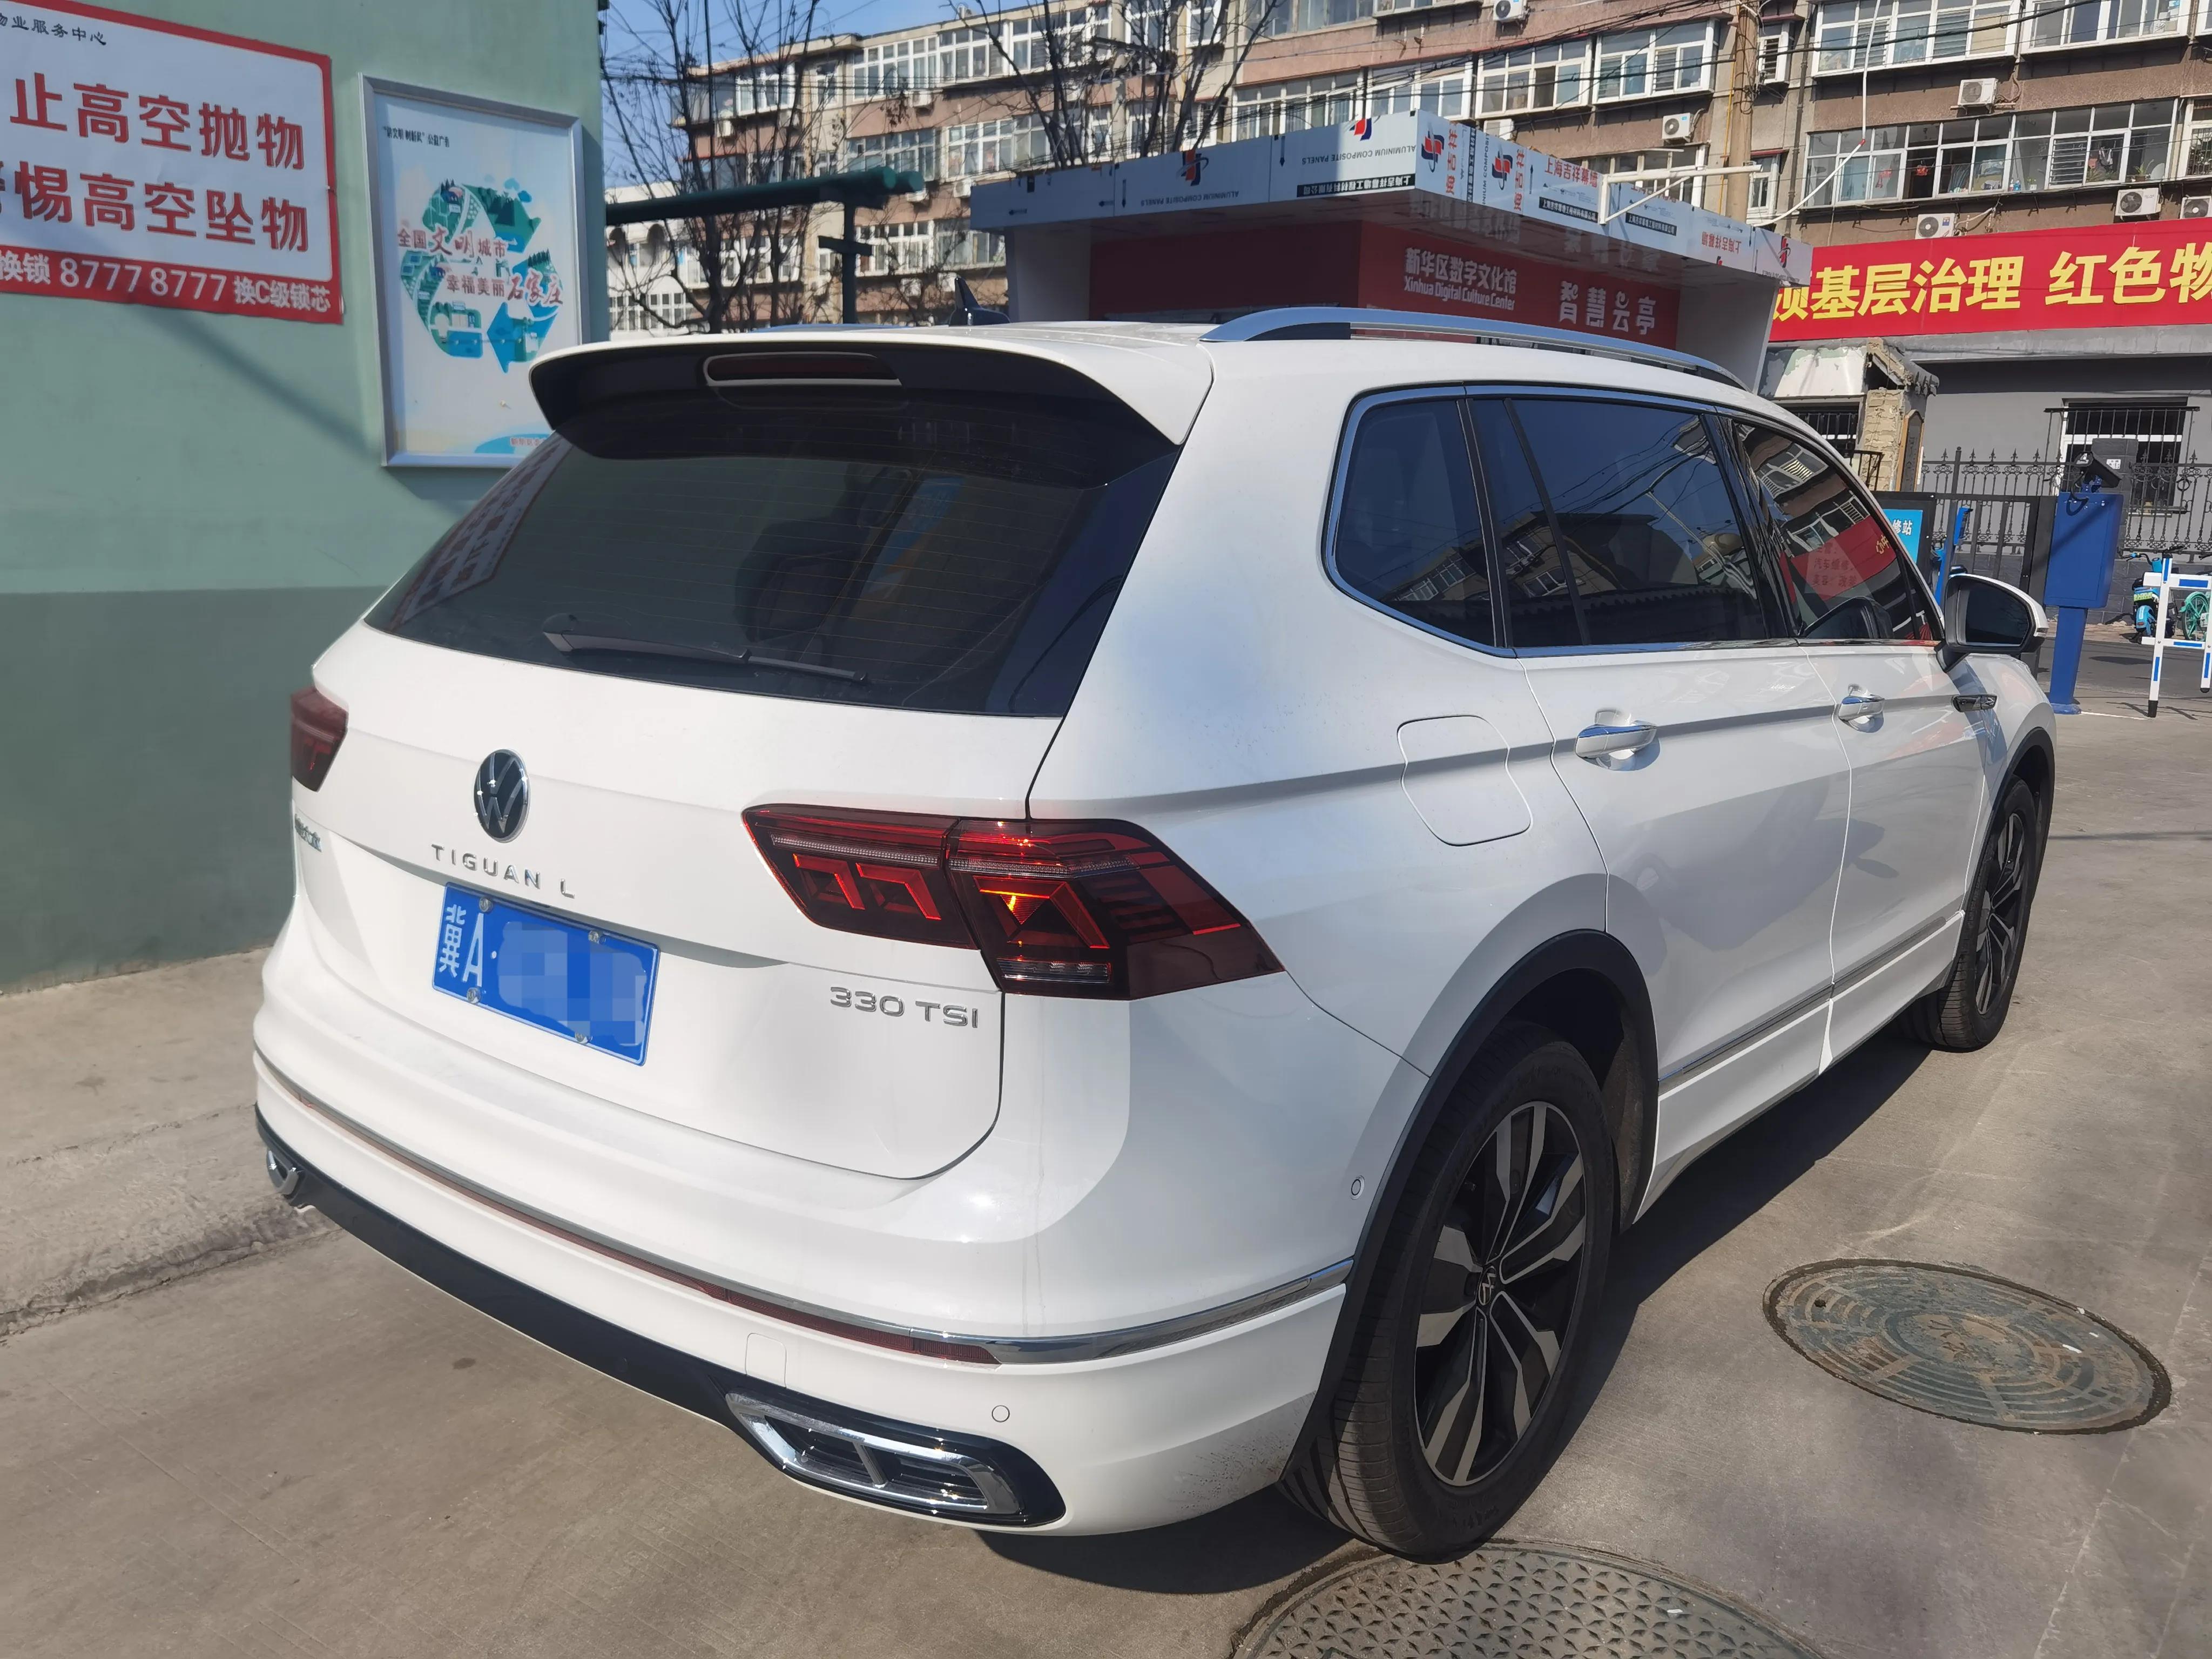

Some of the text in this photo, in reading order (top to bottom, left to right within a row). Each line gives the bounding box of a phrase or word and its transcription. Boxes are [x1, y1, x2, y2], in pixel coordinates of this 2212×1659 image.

[10, 72, 306, 171] 止高空抛物
[1301, 144, 1416, 165] ALUMINIUM COMPOSITE PANELS
[1545, 157, 1599, 188] 上海吉祥幕墙
[0, 160, 309, 253] 惕高空坠物
[397, 226, 507, 258] 全国文明城市
[446, 268, 563, 305] 幸福美丽石家庄
[1405, 247, 1517, 294] 新华区数字文化馆
[2045, 241, 2212, 305] 红色物
[233, 275, 331, 313] 换C级锁芯
[1404, 275, 1515, 311] Xinhua Digital Culture Center
[1559, 280, 1656, 335] 智慧云亭
[1892, 519, 1913, 536] 修站
[431, 844, 576, 899] TIGUAN L
[830, 986, 979, 1029] 330 TSI
